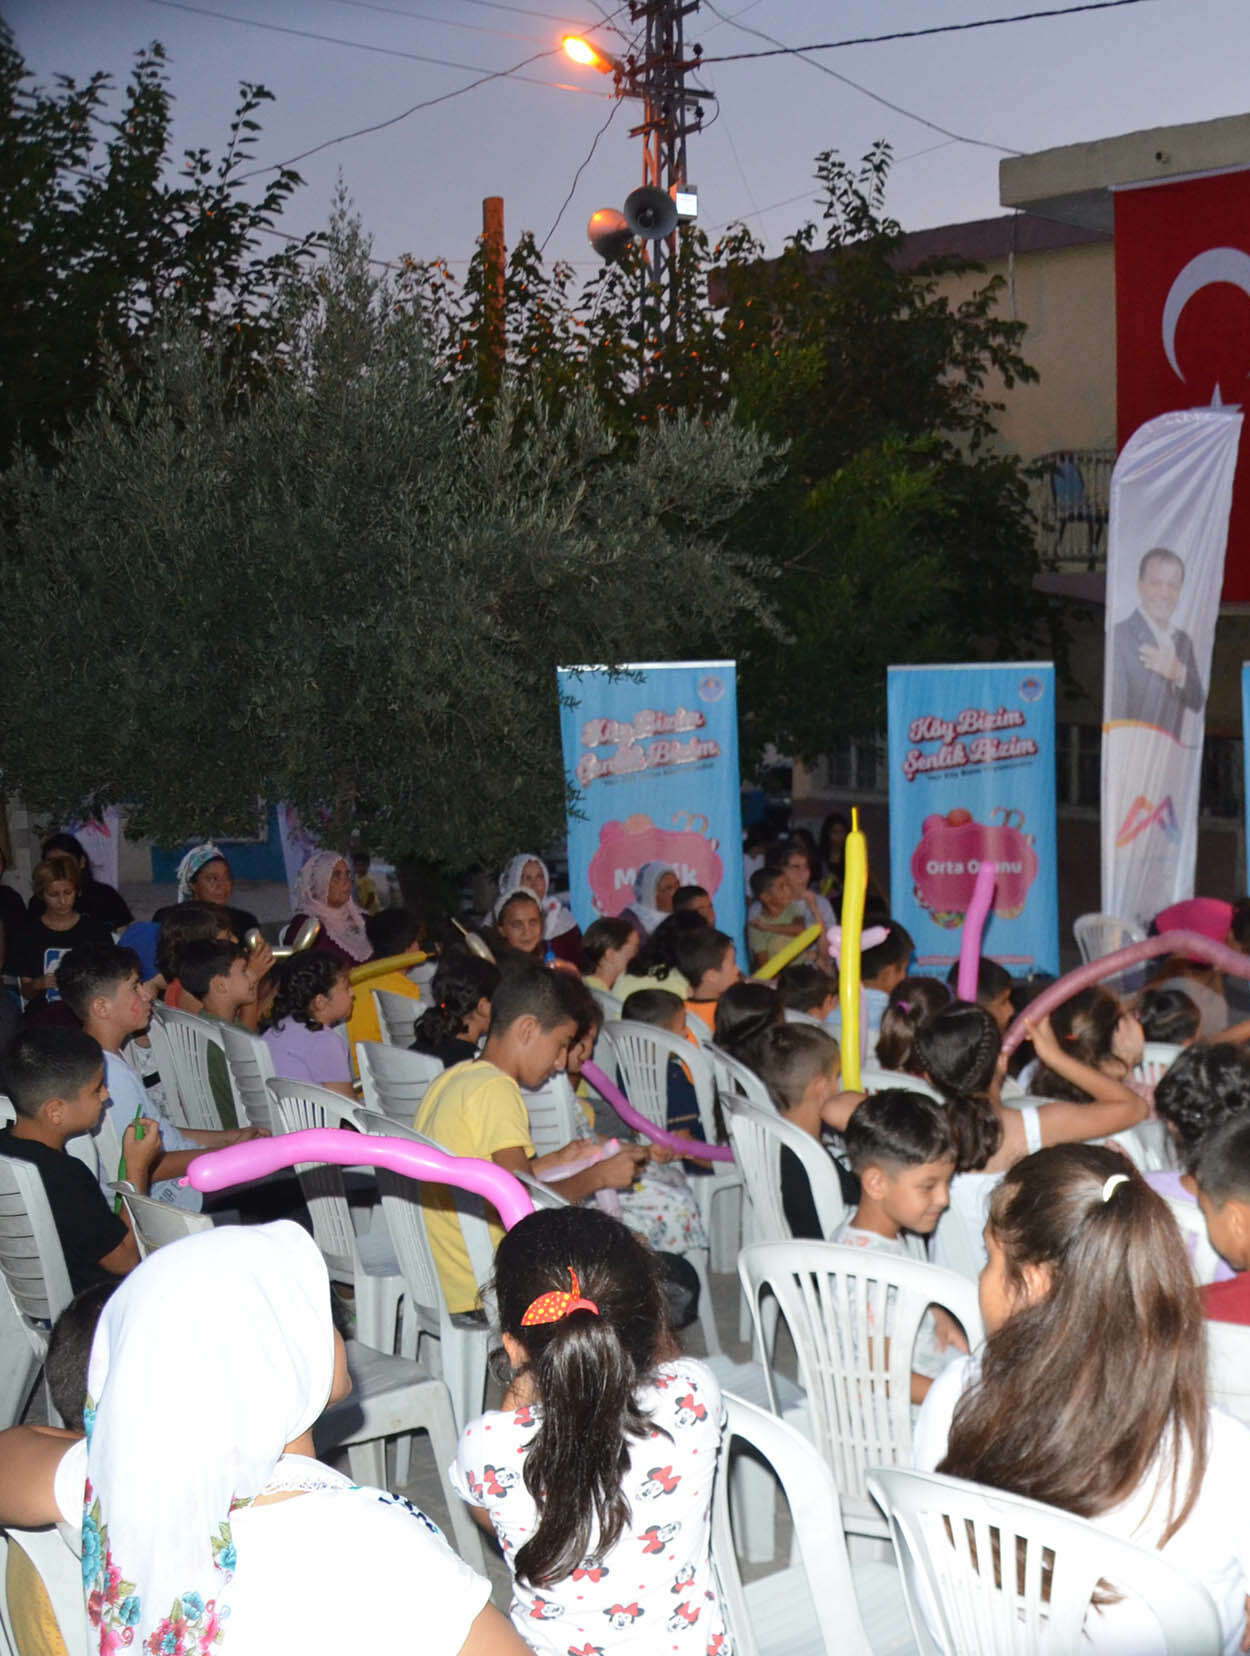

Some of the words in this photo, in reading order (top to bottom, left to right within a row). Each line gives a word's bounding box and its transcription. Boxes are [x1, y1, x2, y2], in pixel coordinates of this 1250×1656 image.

[910, 715, 957, 744] Köy
[956, 705, 1026, 735] Bizim
[904, 742, 969, 782] Şenlik
[968, 734, 1038, 764] Bizim
[613, 863, 698, 890] Mik
[926, 860, 963, 875] Orta
[967, 860, 1022, 875] Onu
